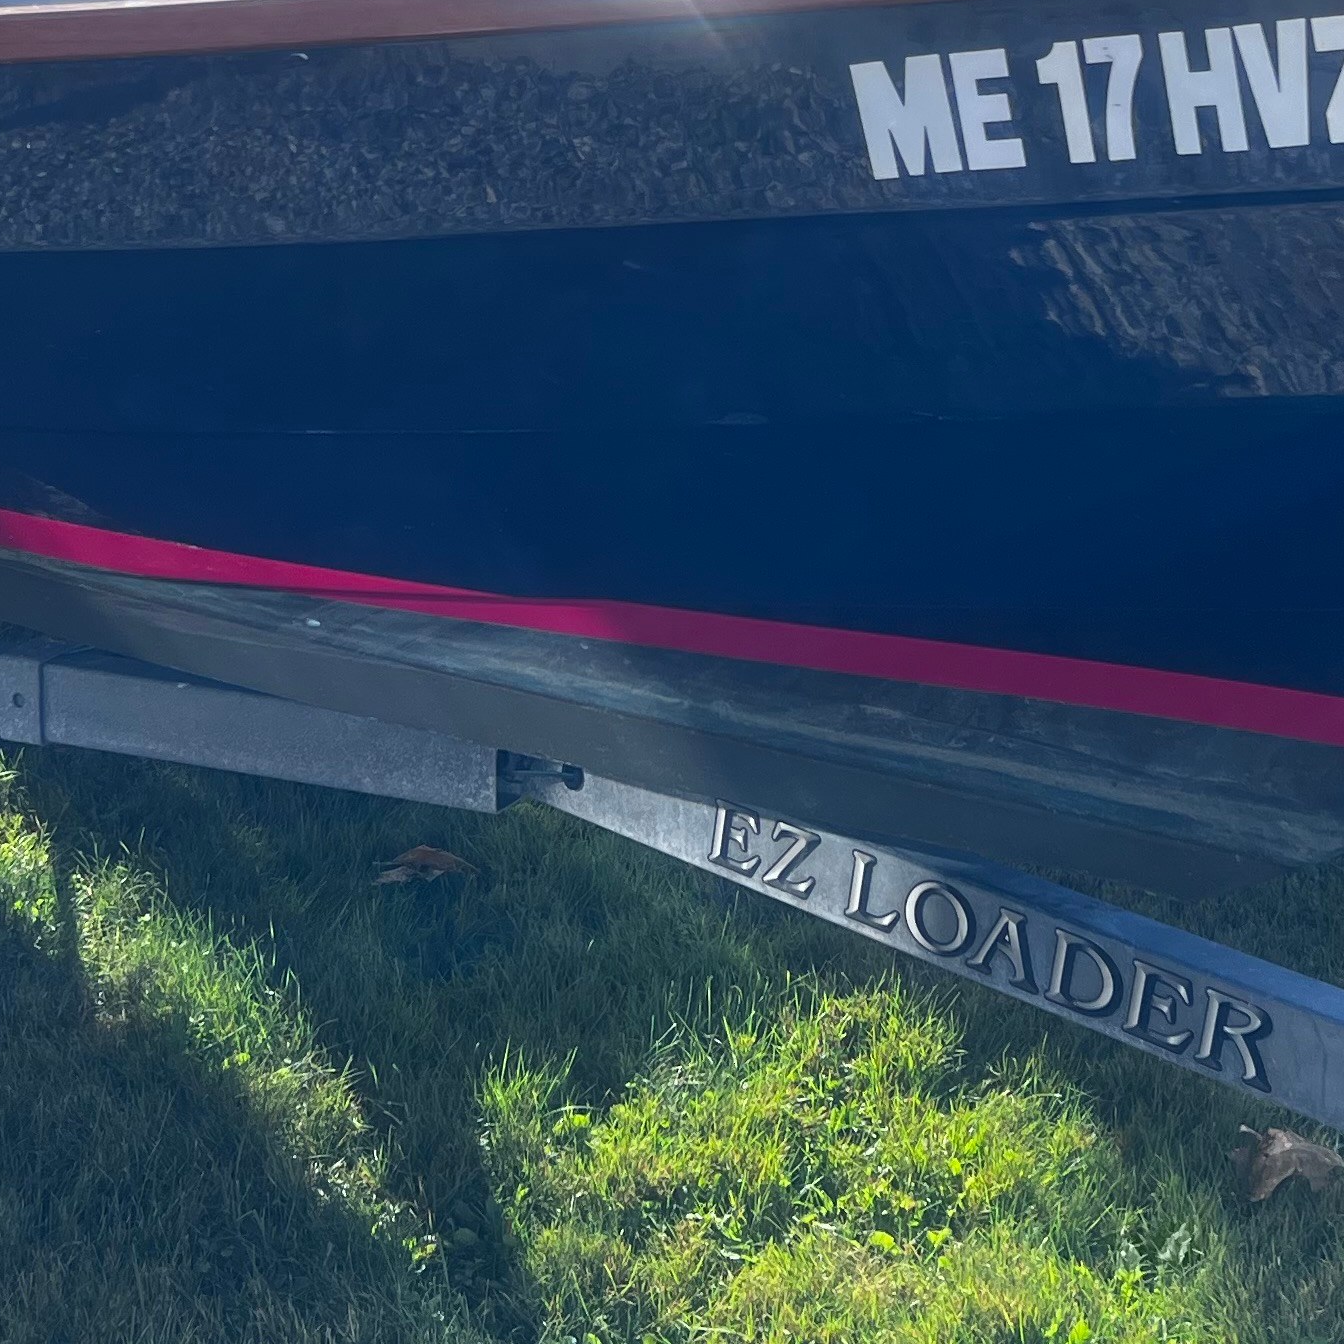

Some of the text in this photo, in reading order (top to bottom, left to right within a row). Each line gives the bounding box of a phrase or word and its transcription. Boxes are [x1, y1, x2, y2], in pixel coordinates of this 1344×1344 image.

[849, 48, 1026, 180] ME
[1036, 34, 1143, 164] 17
[707, 798, 1273, 1093] EZ LOADER
